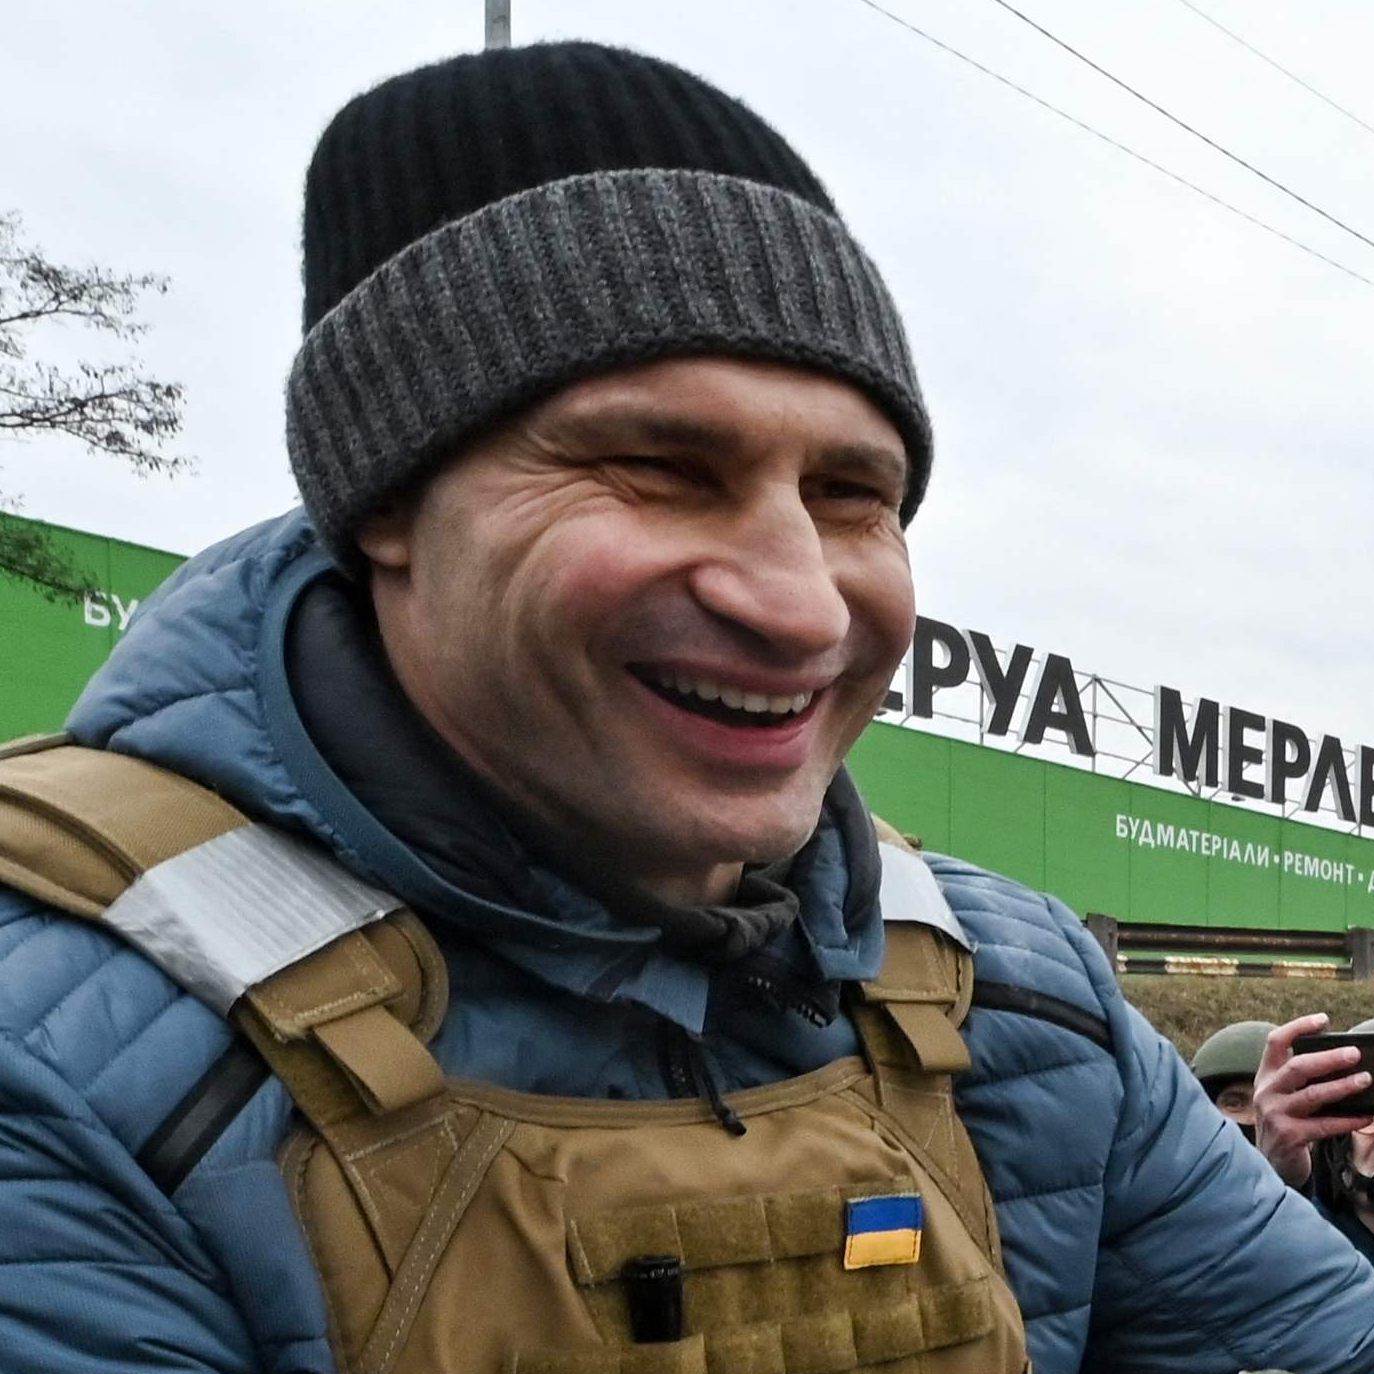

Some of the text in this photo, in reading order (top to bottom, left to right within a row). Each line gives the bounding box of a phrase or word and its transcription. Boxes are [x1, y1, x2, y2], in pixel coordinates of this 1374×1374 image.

[876, 615, 1096, 757] РУА
[1115, 813, 1270, 869] БУДМАТЕРІАЛИ
[1283, 850, 1355, 885] РЕМОНТ
